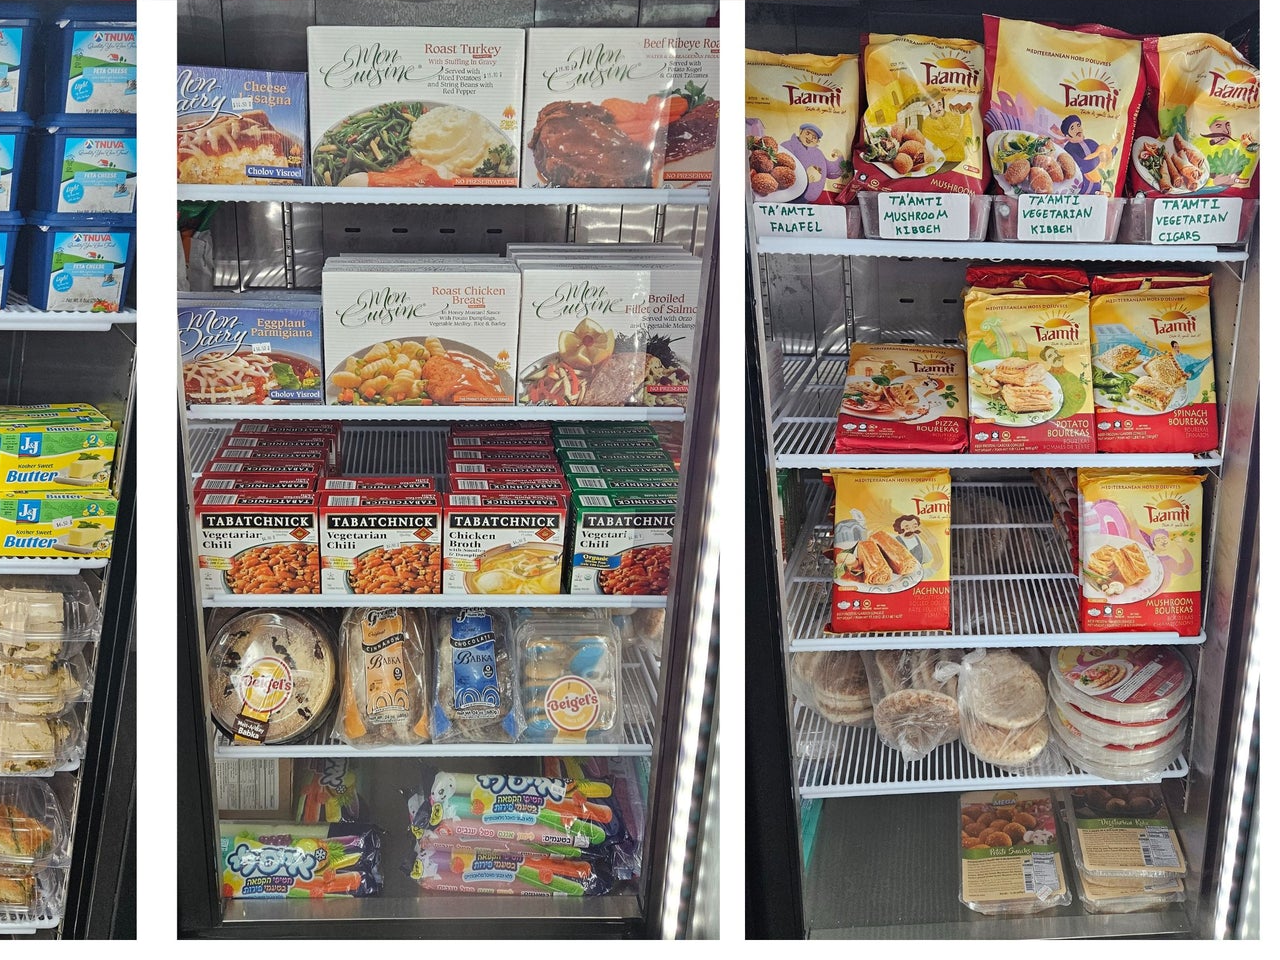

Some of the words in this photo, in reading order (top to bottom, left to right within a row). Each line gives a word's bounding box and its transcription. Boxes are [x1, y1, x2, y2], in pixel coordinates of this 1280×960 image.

[425, 44, 456, 54] Roast
[460, 44, 501, 56] Turkey
[444, 58, 470, 66] Stuffing
[247, 168, 272, 177] Cholov
[274, 168, 301, 177] Yisroel
[889, 195, 942, 207] TA'AMTI
[1028, 194, 1080, 206] TA'AMTI
[1162, 198, 1220, 210] TA'AMTI
[759, 205, 814, 217] TA'AMTI
[884, 210, 948, 223] MUSHROOM
[1022, 207, 1093, 220] VEGETARIAN
[1155, 211, 1228, 225] VEGETARIAN
[771, 222, 822, 234] FALAFEL
[896, 225, 941, 235] KIBBEH
[1031, 223, 1073, 234] KIBBEH
[1158, 230, 1201, 241] CIGARS
[432, 286, 462, 296] Roast
[464, 286, 506, 296] Chicken
[452, 295, 485, 305] Breast
[257, 318, 306, 331] Eggplant
[250, 327, 313, 339] Parmigiana
[1173, 409, 1207, 418] SPINACH
[935, 420, 959, 428] PIZZA
[1056, 420, 1089, 428] POTATO
[1168, 417, 1208, 426] BOUREKAS
[207, 515, 309, 527] TABATCHNICK
[454, 515, 554, 527] TABATCHNICK
[327, 531, 387, 542] Vegetarian
[449, 531, 496, 540] Chicken
[4, 537, 57, 549] Butter
[327, 541, 356, 550] Chili
[449, 540, 481, 548] Broth
[1146, 598, 1193, 607] MUSHROOM
[1155, 606, 1193, 614] BOUREKAS
[546, 696, 598, 712] Beigel's
